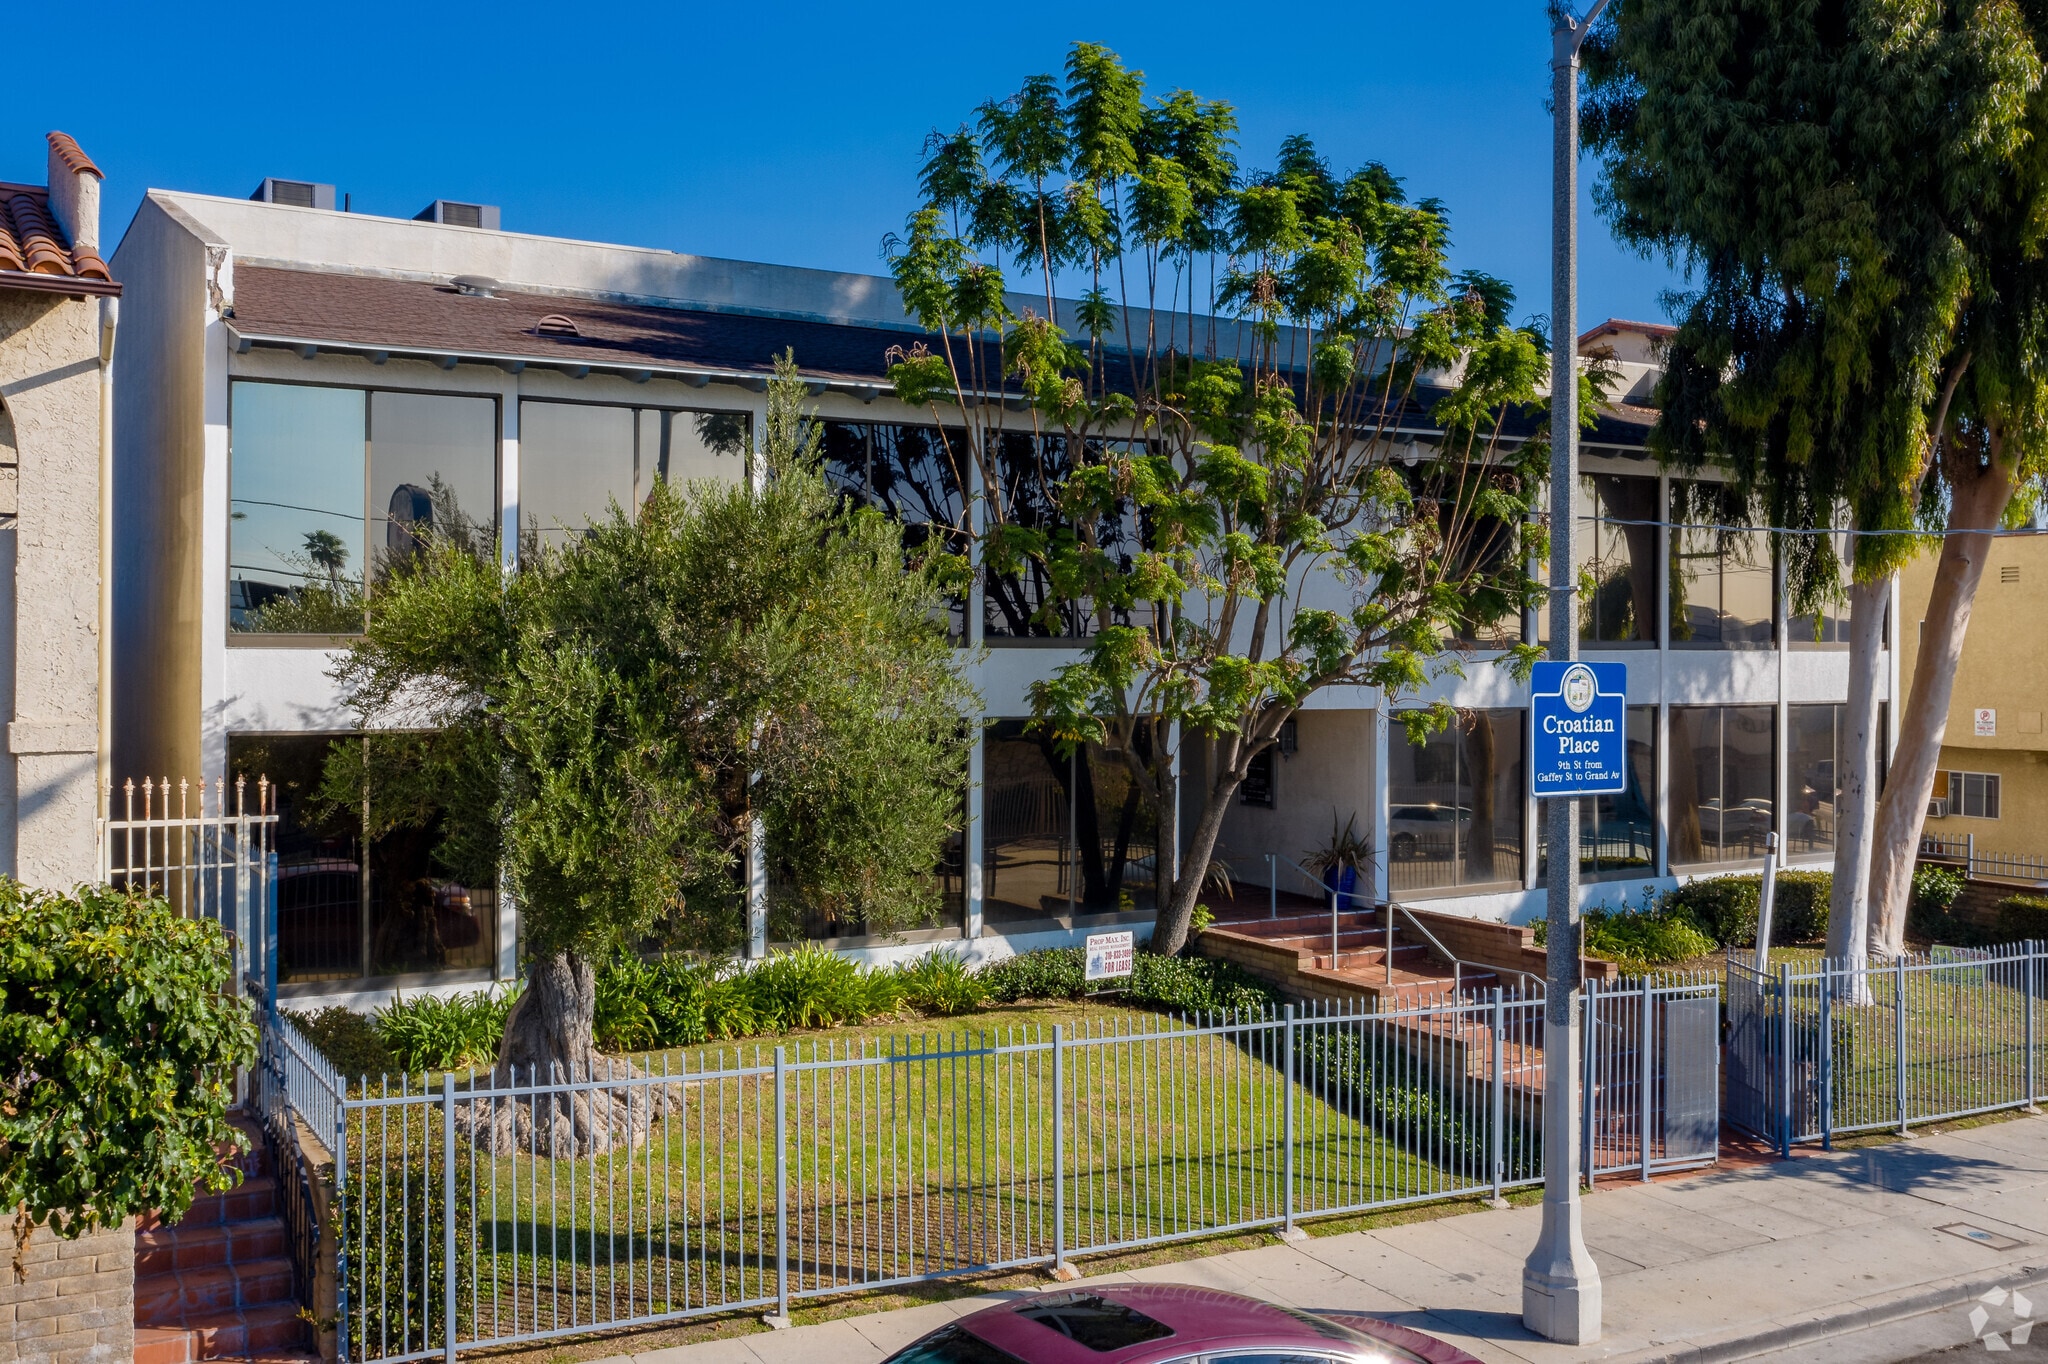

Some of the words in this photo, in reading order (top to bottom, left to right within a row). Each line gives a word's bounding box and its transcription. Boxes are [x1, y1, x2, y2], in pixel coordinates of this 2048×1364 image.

[1543, 714, 1614, 734] Croatian
[1558, 736, 1599, 754] Place
[1557, 760, 1571, 770] 9th
[1573, 760, 1582, 770] St
[1584, 760, 1602, 769] from
[1537, 772, 1563, 783] Gaffey
[1565, 771, 1573, 781] St
[1575, 772, 1583, 781] to
[1584, 771, 1608, 780] Grand
[1610, 771, 1620, 780] Av
[1104, 961, 1115, 973] FOR
[1116, 959, 1131, 972] LEASE
